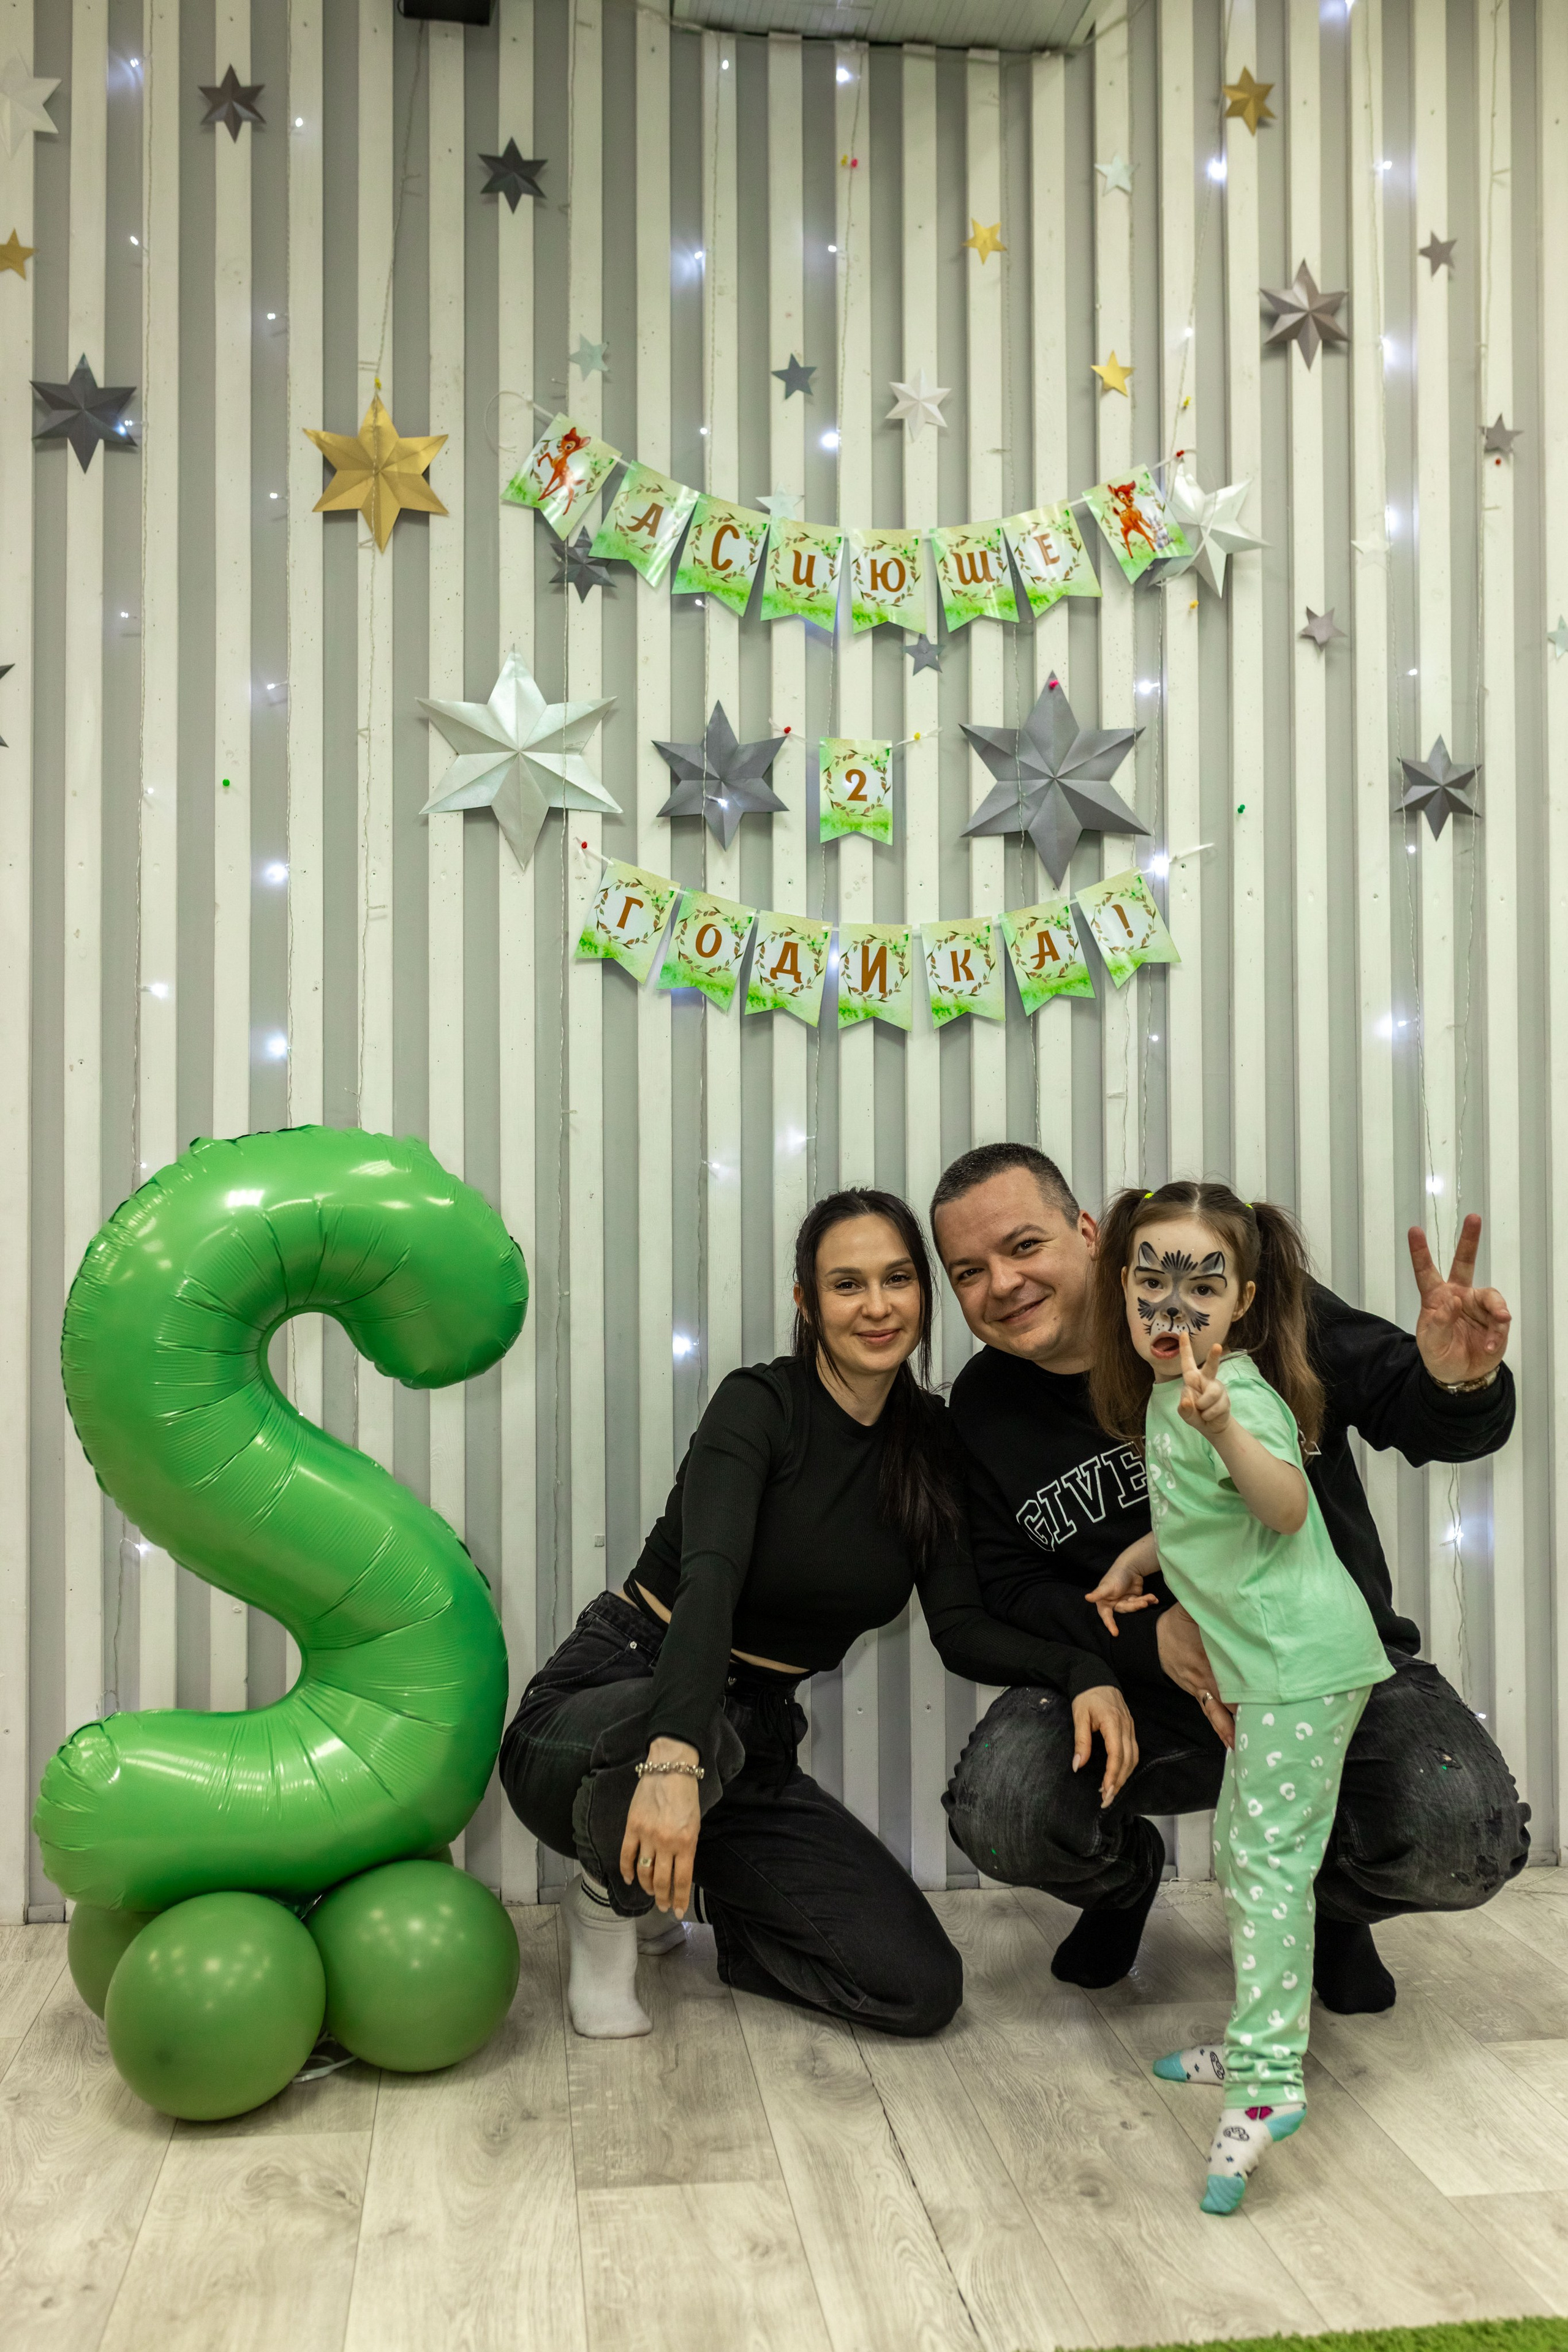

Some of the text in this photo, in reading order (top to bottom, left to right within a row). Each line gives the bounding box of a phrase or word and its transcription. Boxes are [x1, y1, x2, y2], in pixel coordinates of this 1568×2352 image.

[845, 768, 868, 802] 2
[616, 895, 1134, 993] ГОДИКА!
[1016, 1439, 1150, 1552] GIVE
